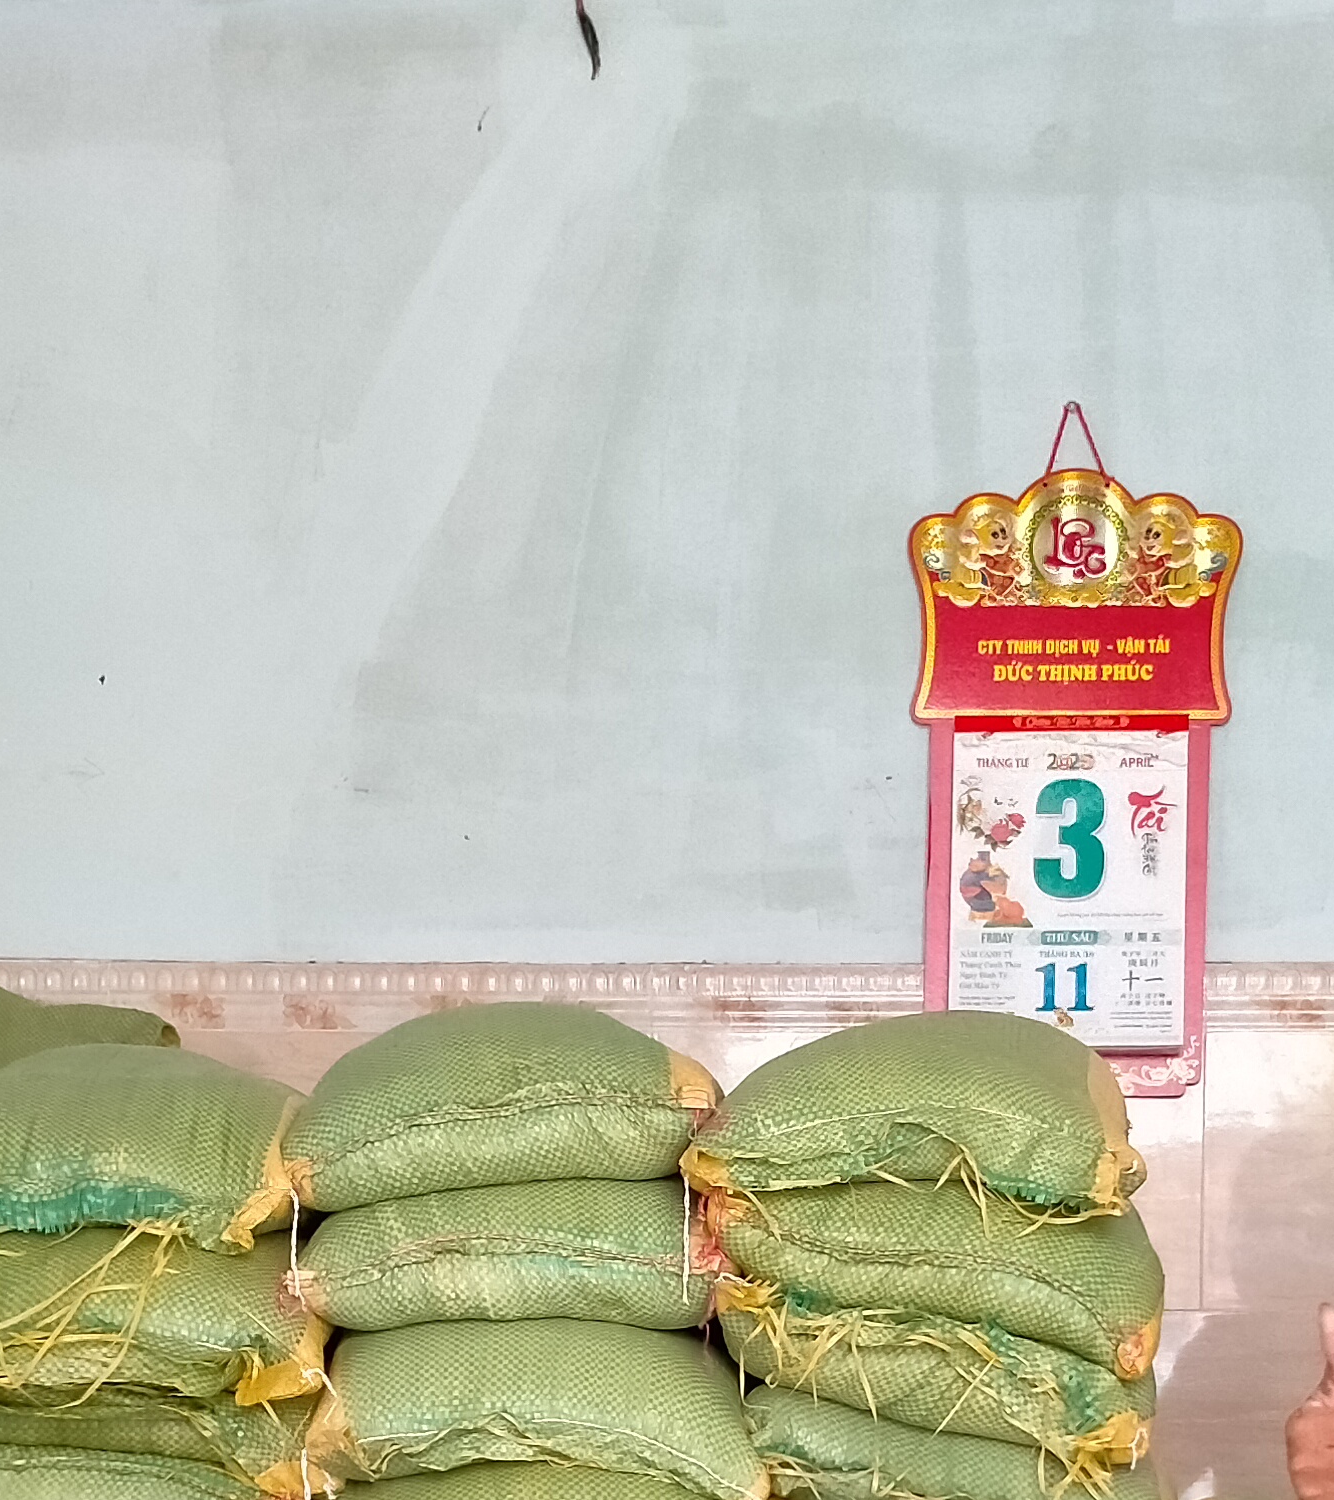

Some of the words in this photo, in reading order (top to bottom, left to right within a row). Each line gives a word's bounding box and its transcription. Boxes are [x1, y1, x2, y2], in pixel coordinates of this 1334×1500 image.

[977, 639, 1004, 655] CTY
[1006, 638, 1044, 655] TNHH
[1045, 638, 1078, 658] DỊCH
[1081, 638, 1100, 658] VỤ
[1116, 635, 1146, 657] VẬN
[993, 659, 1034, 682] ĐỨC
[1036, 664, 1098, 685] THỊNH
[1100, 659, 1154, 681] PHÚC
[1119, 757, 1154, 768] APRIL
[1033, 778, 1105, 899] 3
[981, 932, 1014, 944] FRIDAY
[1035, 961, 1096, 1011] 11
[1121, 970, 1165, 991] 十一
